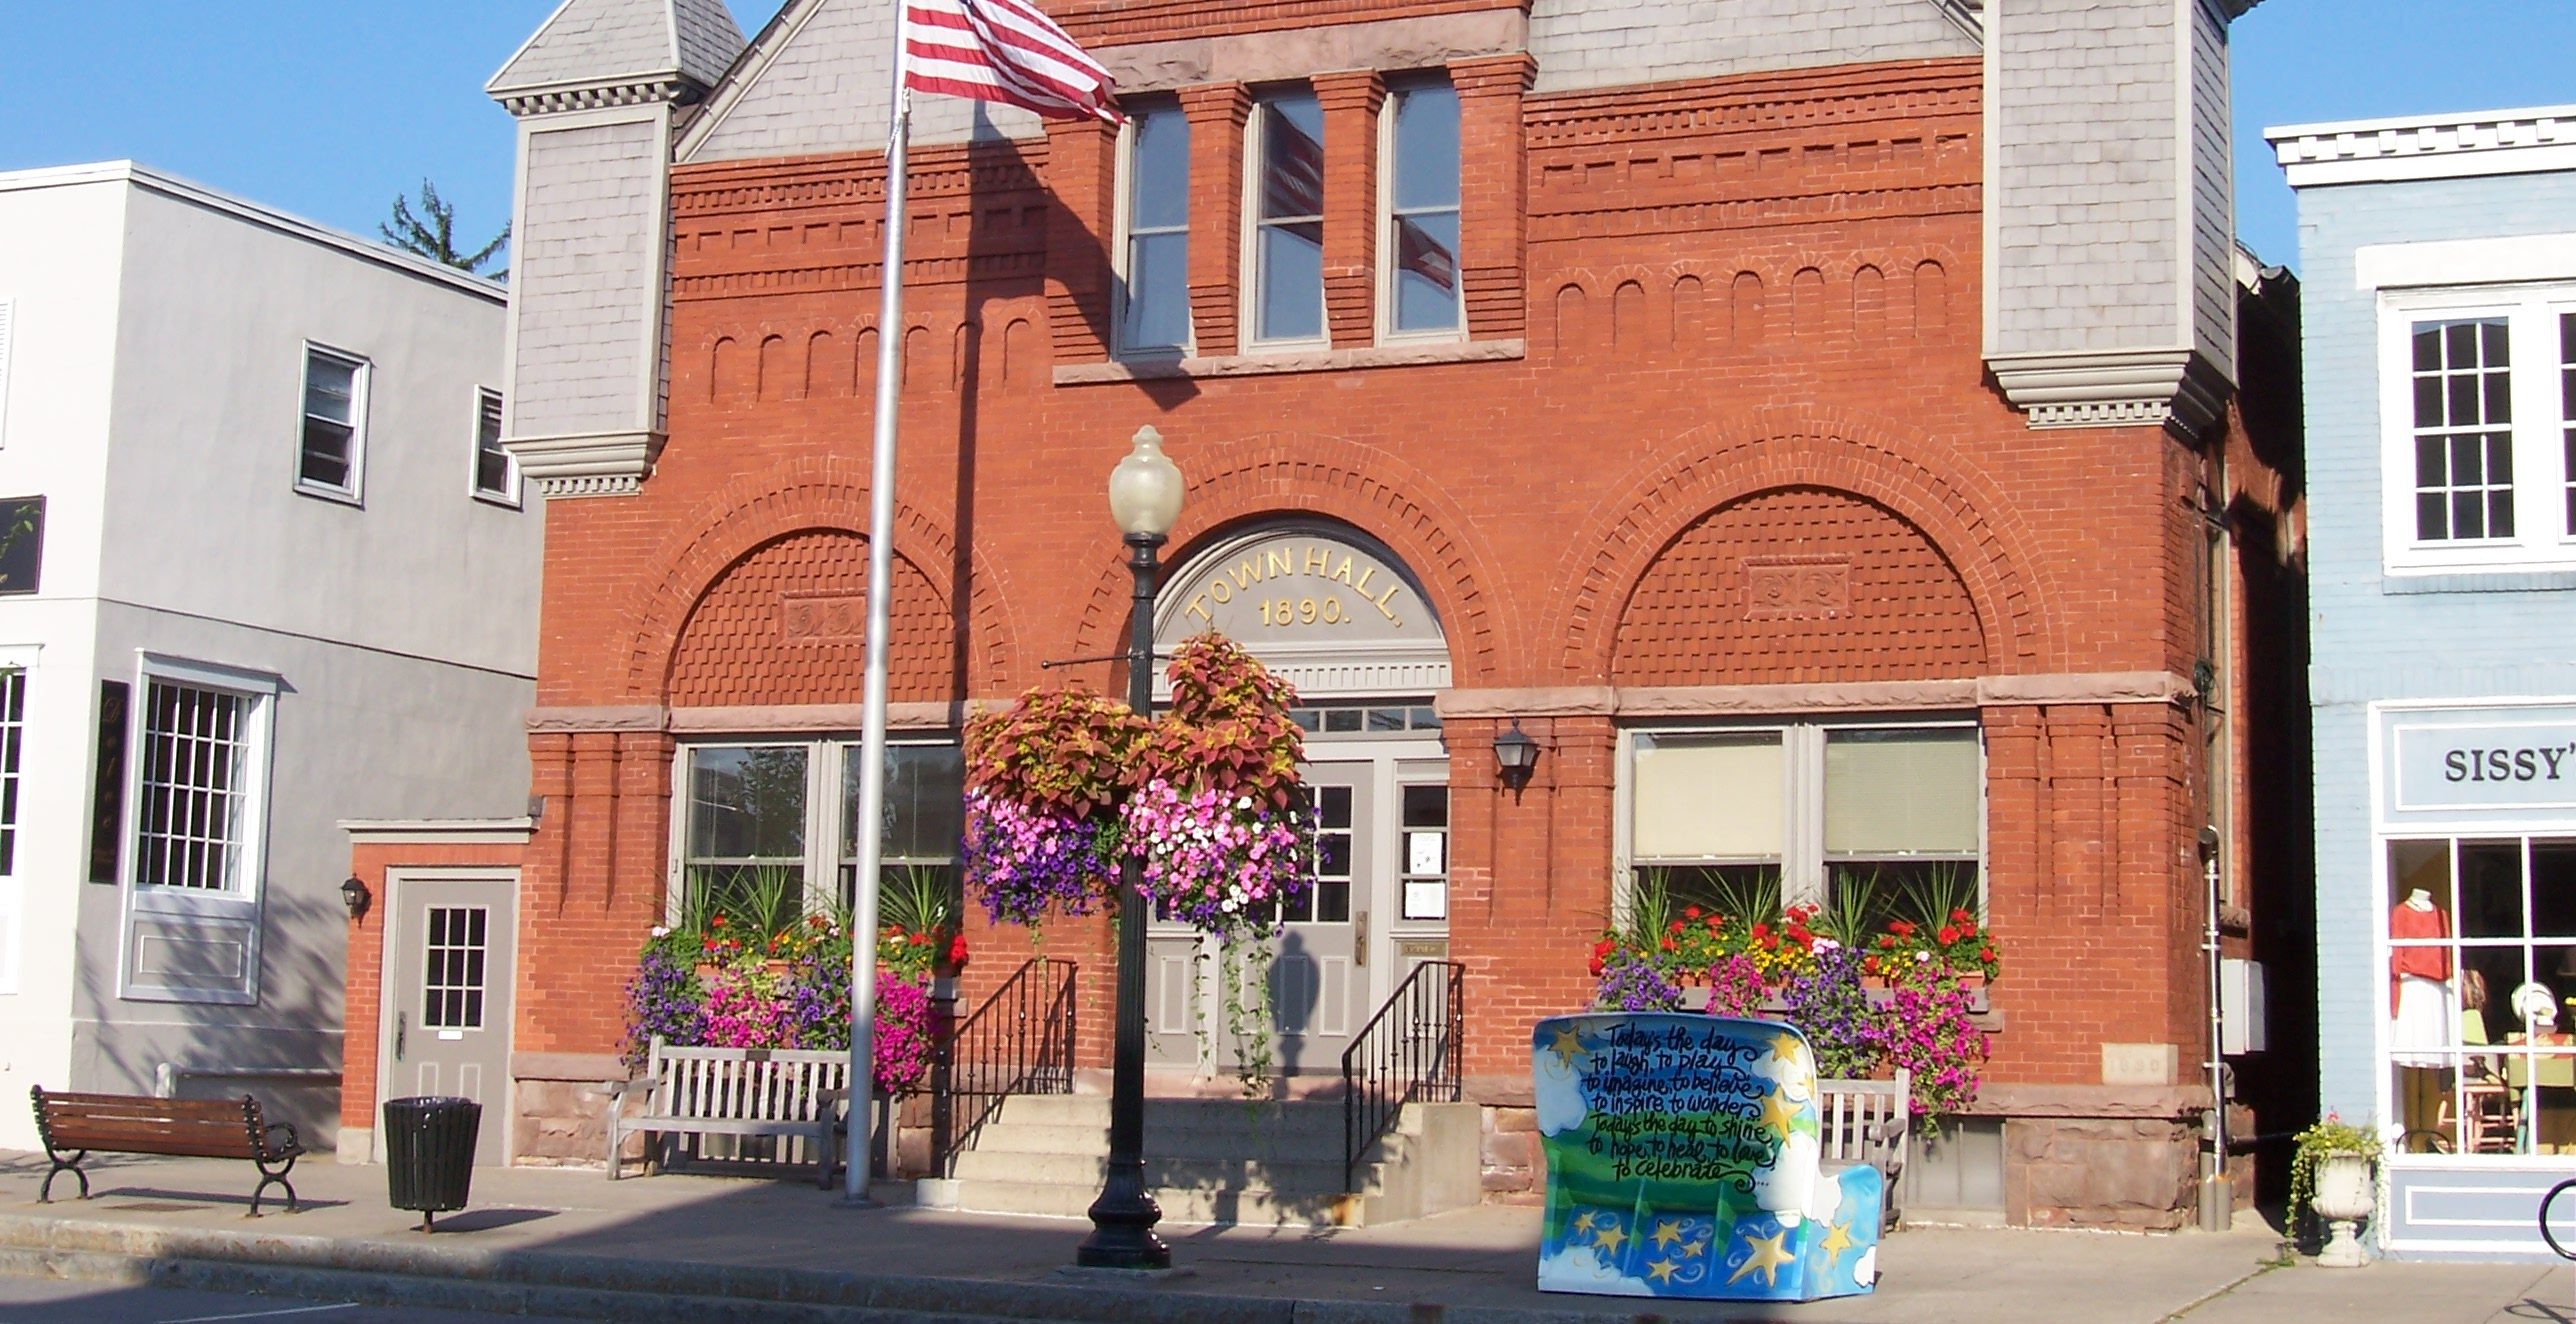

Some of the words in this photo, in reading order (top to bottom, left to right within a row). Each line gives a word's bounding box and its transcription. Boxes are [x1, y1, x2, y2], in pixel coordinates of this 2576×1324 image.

[1184, 547, 1293, 623] TOWN
[1259, 597, 1352, 626] 1890.
[1604, 1022, 1661, 1056] Today's
[1665, 1024, 1695, 1053] the
[1700, 1026, 1758, 1065] day
[1590, 1052, 1608, 1075] to
[1656, 1050, 1673, 1070] to
[1581, 1073, 1601, 1092] to
[1669, 1072, 1690, 1091] to
[1592, 1093, 1608, 1112] to
[1669, 1093, 1685, 1114] to
[1643, 1111, 1667, 1135] the
[1668, 1115, 1704, 1143] day
[1700, 1116, 1717, 1136] to
[1586, 1134, 1603, 1155] to
[1646, 1136, 1665, 1157] to
[1706, 1137, 1729, 1160] to
[1612, 1158, 1631, 1182] to
